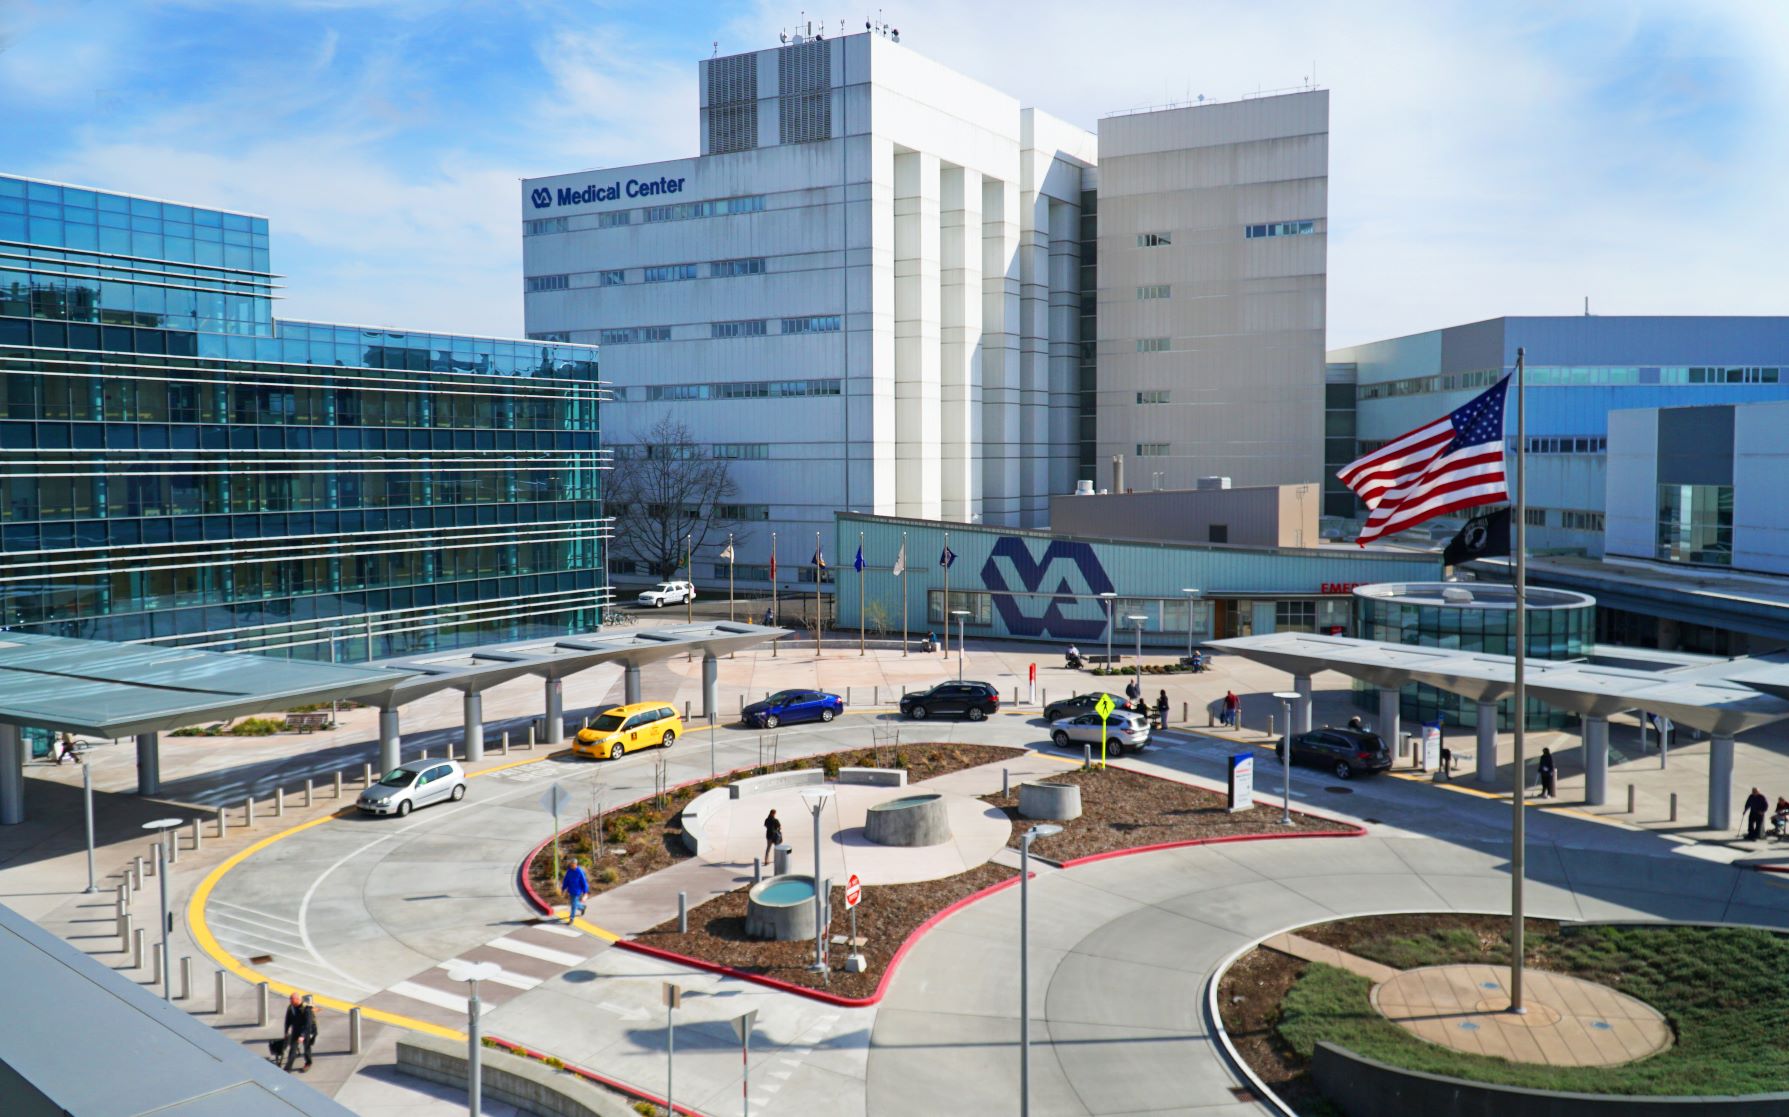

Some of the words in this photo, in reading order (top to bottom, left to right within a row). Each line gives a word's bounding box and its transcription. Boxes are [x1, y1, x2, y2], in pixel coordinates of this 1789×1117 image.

[557, 181, 620, 206] Medical
[626, 177, 685, 198] Center
[980, 536, 1115, 640] VA
